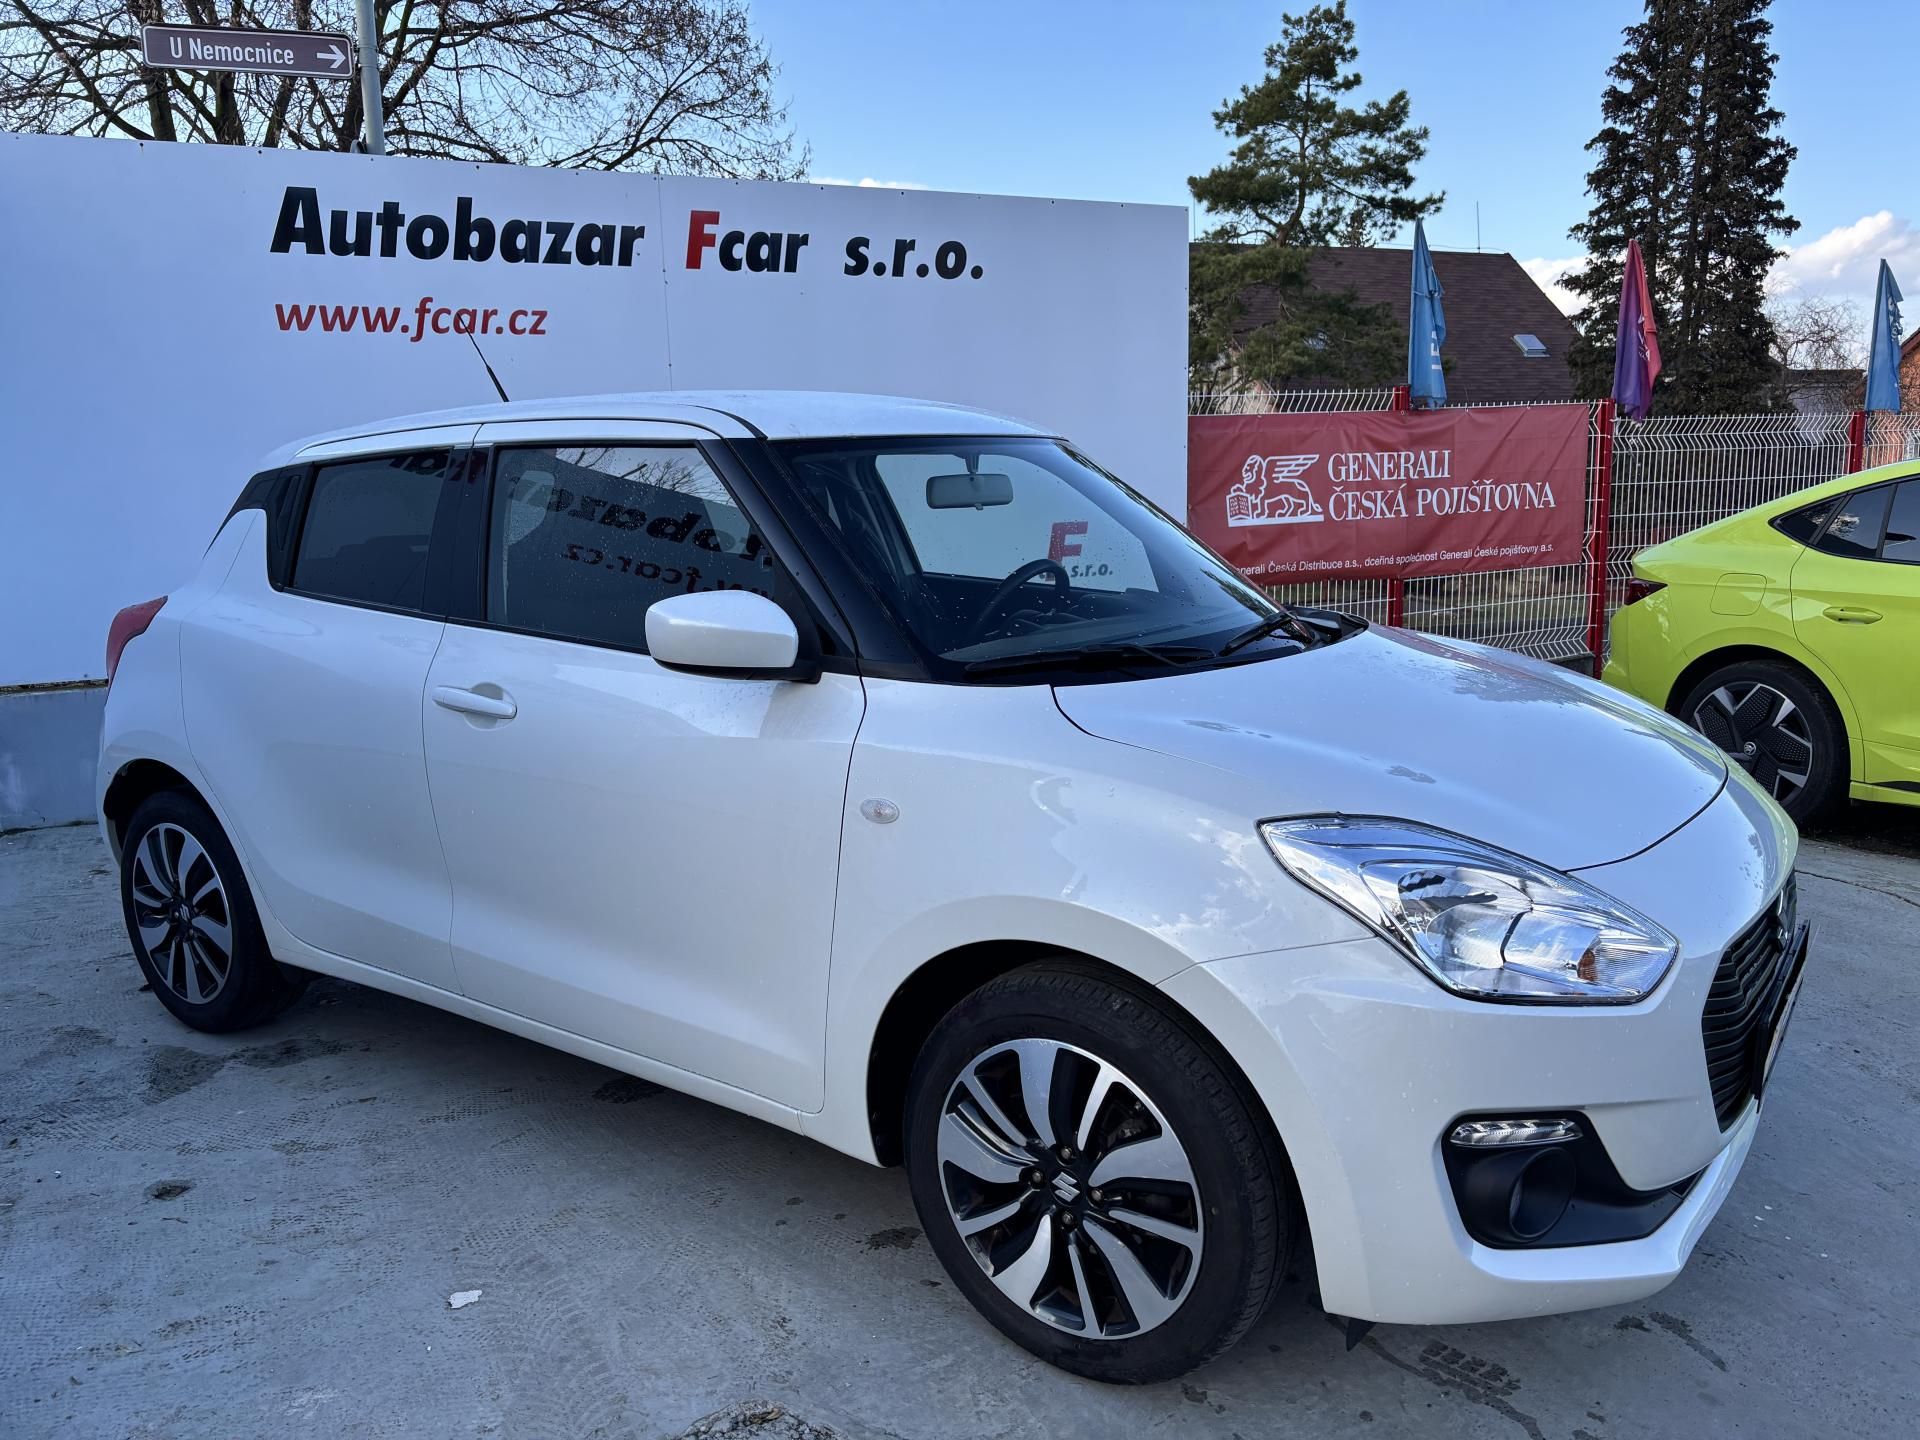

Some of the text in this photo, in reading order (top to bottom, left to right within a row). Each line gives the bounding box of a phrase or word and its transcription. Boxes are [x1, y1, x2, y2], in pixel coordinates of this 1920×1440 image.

[169, 36, 294, 65] U Nemocnice
[270, 186, 984, 280] Autobazar Fcar s.r.o.
[275, 296, 548, 343] www.fcar.cz
[1327, 450, 1452, 482] GENERALI
[1328, 479, 1557, 522] ČESKÁ POJIŠŤOVNA
[1070, 563, 1114, 578] s.r.o.
[1268, 560, 1297, 573] Česká
[1299, 559, 1343, 572] Distribuce
[1364, 554, 1394, 567] dceřiná
[1395, 551, 1438, 566] společnost
[1439, 548, 1473, 561] Generali
[1474, 545, 1499, 558] České
[1499, 544, 1539, 557] pojišťovny
[1540, 543, 1554, 552] a.s.
